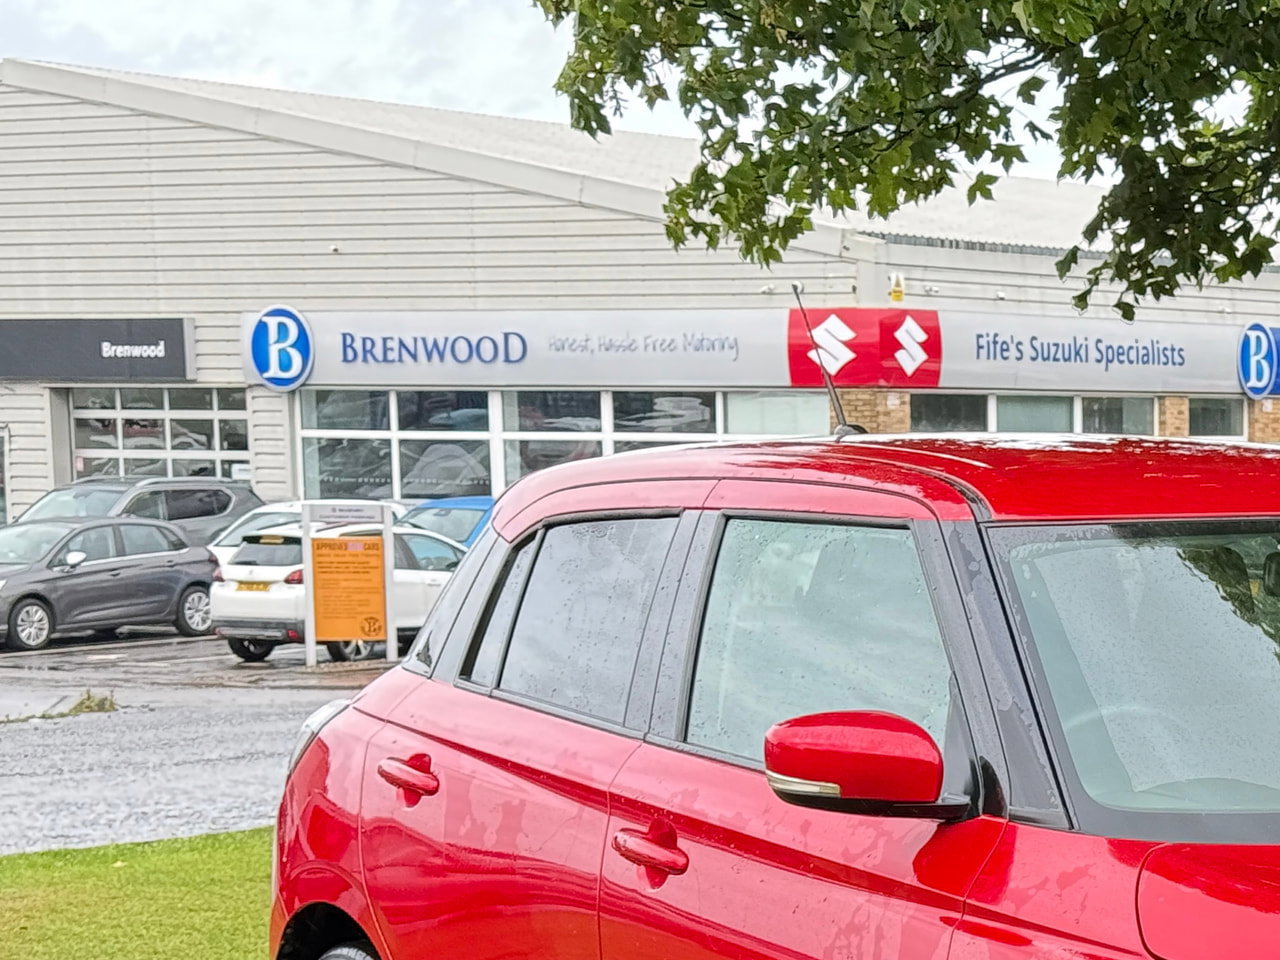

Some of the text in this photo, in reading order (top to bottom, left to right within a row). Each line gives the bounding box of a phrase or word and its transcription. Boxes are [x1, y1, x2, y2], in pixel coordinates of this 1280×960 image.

[101, 340, 166, 358] Brenwood
[341, 332, 528, 364] BRENWOOD
[643, 336, 677, 352] Free
[683, 333, 739, 362] Motoring
[975, 333, 1186, 372] Fife's Suzuki Specialists
